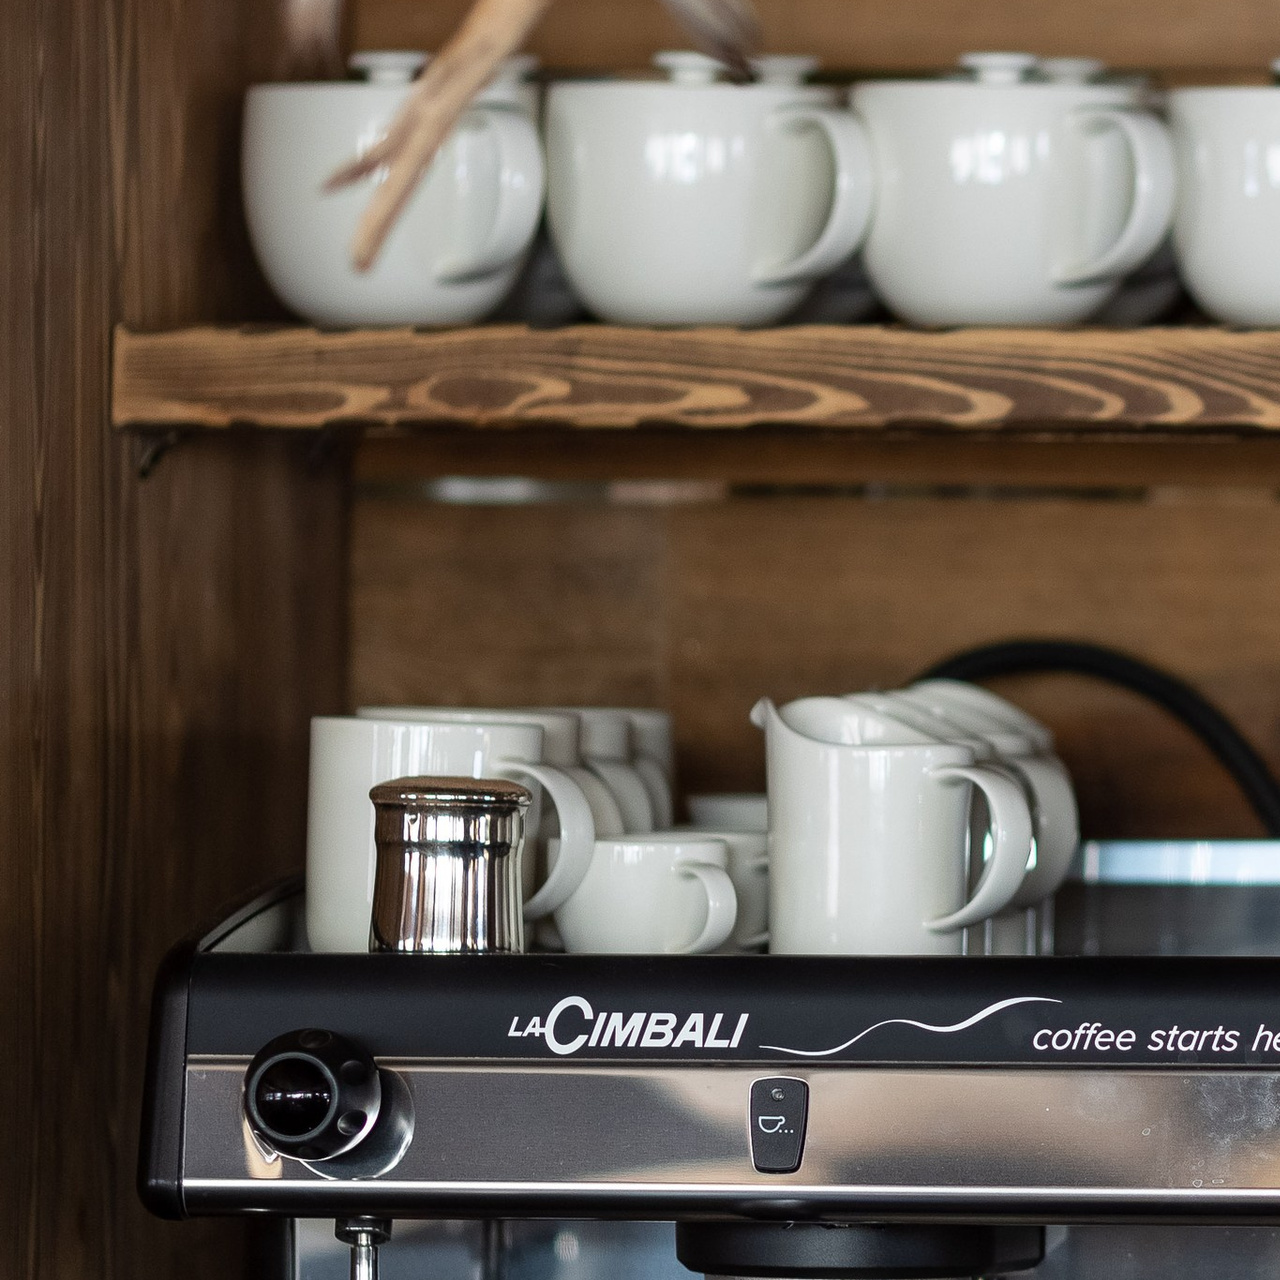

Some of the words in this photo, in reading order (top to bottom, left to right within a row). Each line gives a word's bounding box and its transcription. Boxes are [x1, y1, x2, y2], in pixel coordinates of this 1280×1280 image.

[544, 995, 750, 1056] CIMBALI
[1032, 1022, 1137, 1051] coffee
[1147, 1025, 1241, 1052] starts
